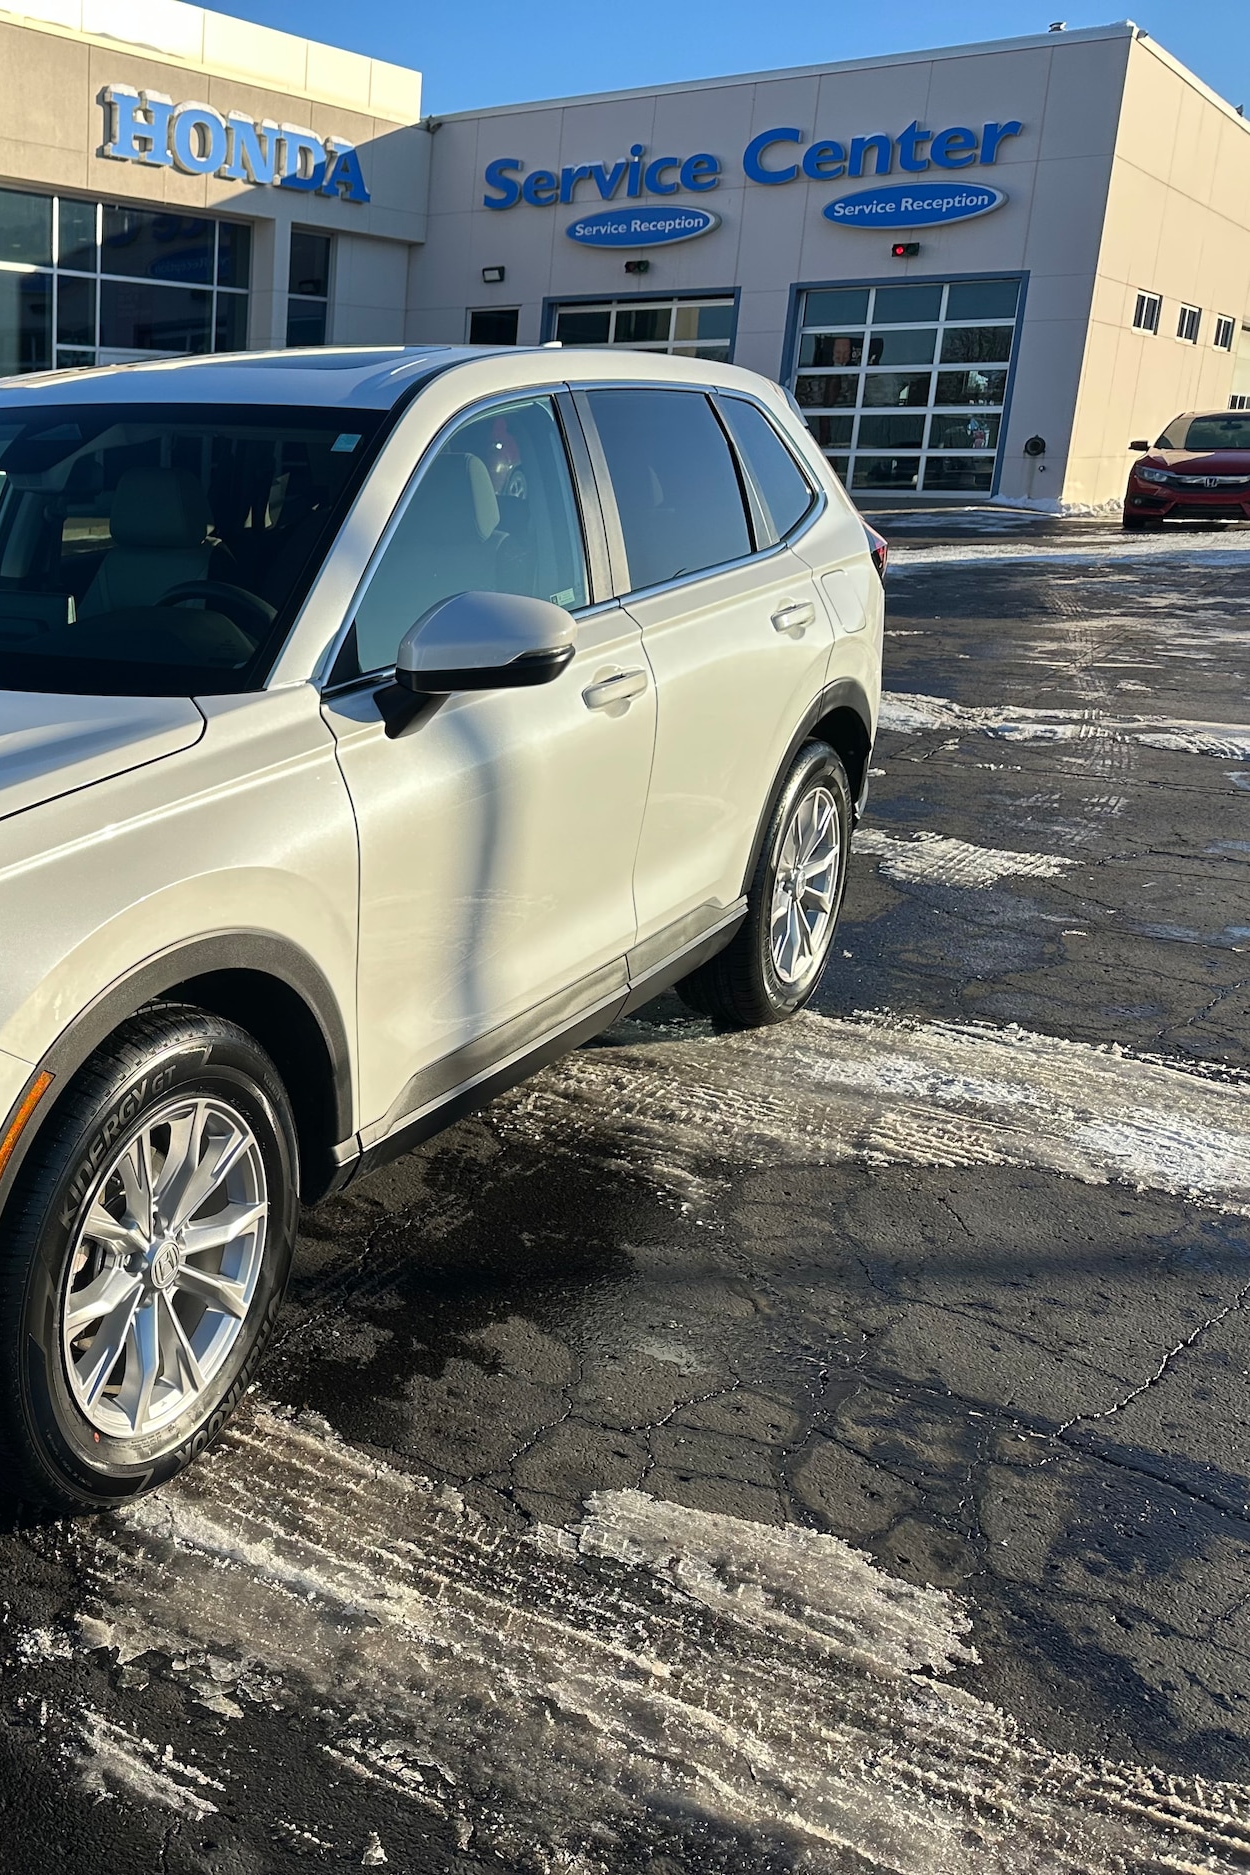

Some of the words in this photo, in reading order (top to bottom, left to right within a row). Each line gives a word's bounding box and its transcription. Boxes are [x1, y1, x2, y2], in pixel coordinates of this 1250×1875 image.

[103, 87, 371, 203] HONDA
[483, 143, 721, 210] Service
[743, 120, 1023, 185] Center
[575, 222, 627, 237] Service
[630, 216, 704, 233] Reception
[833, 200, 896, 217] Service
[900, 193, 989, 212] Reception
[58, 1078, 149, 1231] KINERGY
[152, 1064, 177, 1095] GT
